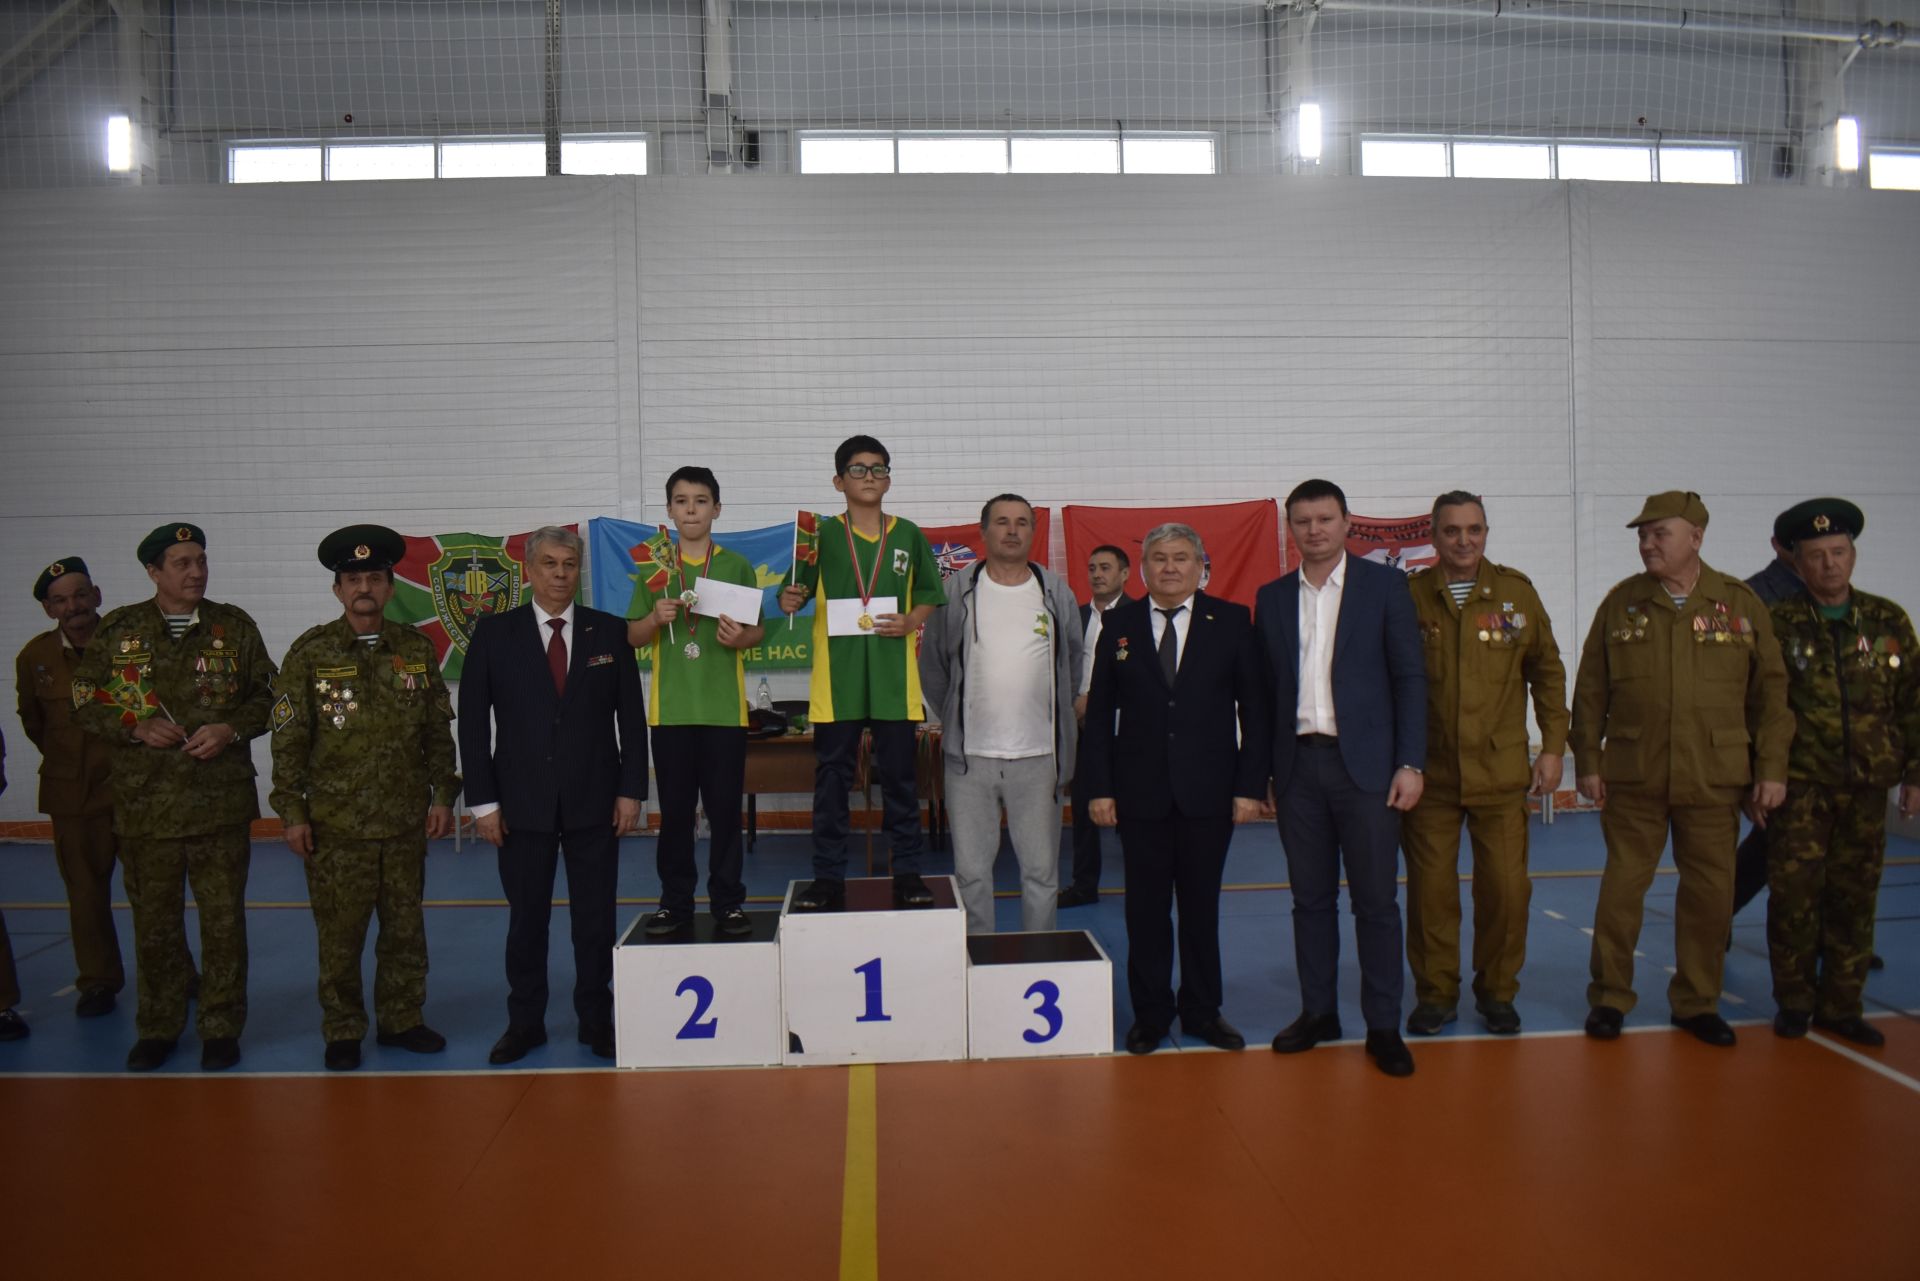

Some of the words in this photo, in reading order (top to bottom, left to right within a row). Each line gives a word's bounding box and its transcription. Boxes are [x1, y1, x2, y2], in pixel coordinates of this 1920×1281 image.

[433, 577, 468, 651] СОДРУЖЕСТВ
[767, 644, 807, 660] НАС
[675, 975, 718, 1040] 2
[853, 957, 892, 1022] 1
[1022, 979, 1064, 1044] 3
